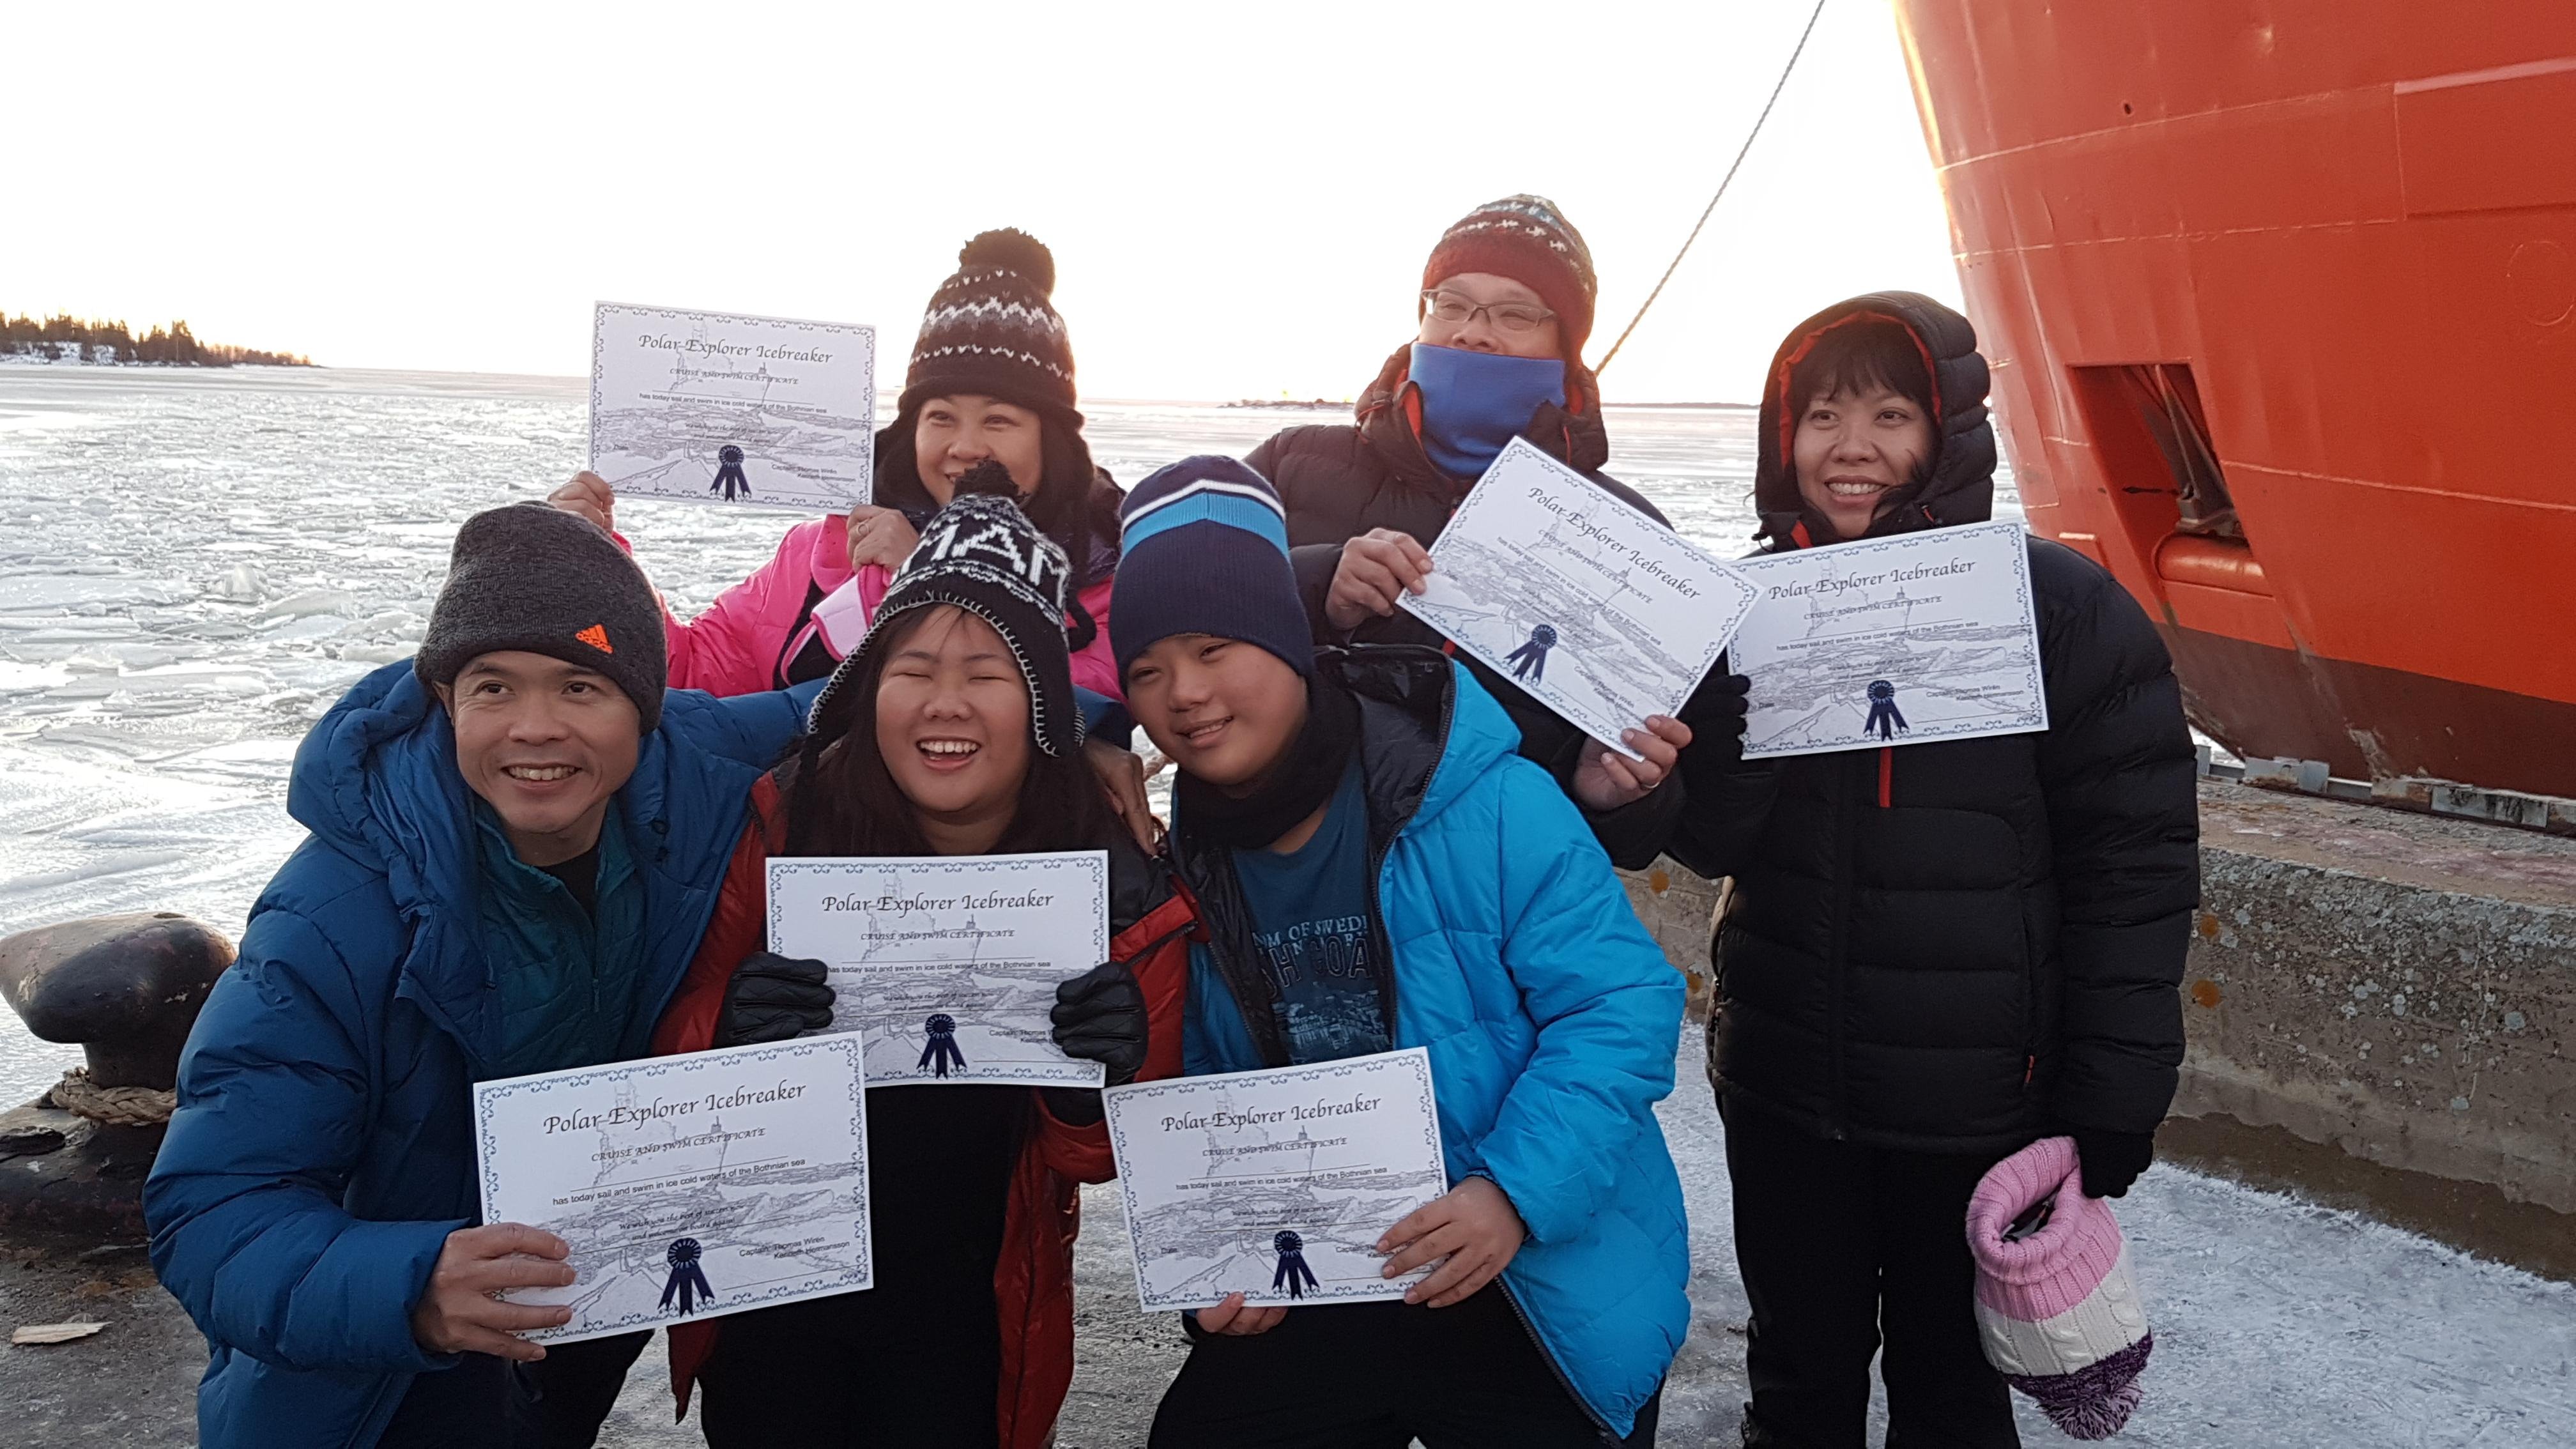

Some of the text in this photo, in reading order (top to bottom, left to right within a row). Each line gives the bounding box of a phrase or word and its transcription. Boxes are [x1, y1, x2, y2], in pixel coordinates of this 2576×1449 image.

[638, 334, 833, 363] Polar Explorer Icebreaker
[1528, 487, 1701, 599] Polar Explorer Icebreaker
[1768, 557, 1976, 600] Polar Explorer Icebreaker
[822, 888, 1054, 919] Polar Explorer Icebreaker
[1289, 922, 1310, 940] OF
[543, 1079, 806, 1134] Polar Explorer Icebreaker
[1161, 1093, 1381, 1133] Polar Explorer Icebreaker
[592, 1127, 766, 1161] CRUISE AND SWIM CERTIFICATE
[553, 1196, 568, 1206] has
[571, 1192, 595, 1204] today
[597, 1189, 611, 1198] sail
[614, 1186, 629, 1196] and
[632, 1183, 654, 1192] swim
[656, 1180, 663, 1188] in
[666, 1179, 678, 1187] ice
[680, 1176, 697, 1184] cold
[699, 1172, 726, 1181] waters
[728, 1169, 737, 1177] of
[753, 1160, 788, 1172] Bothnian
